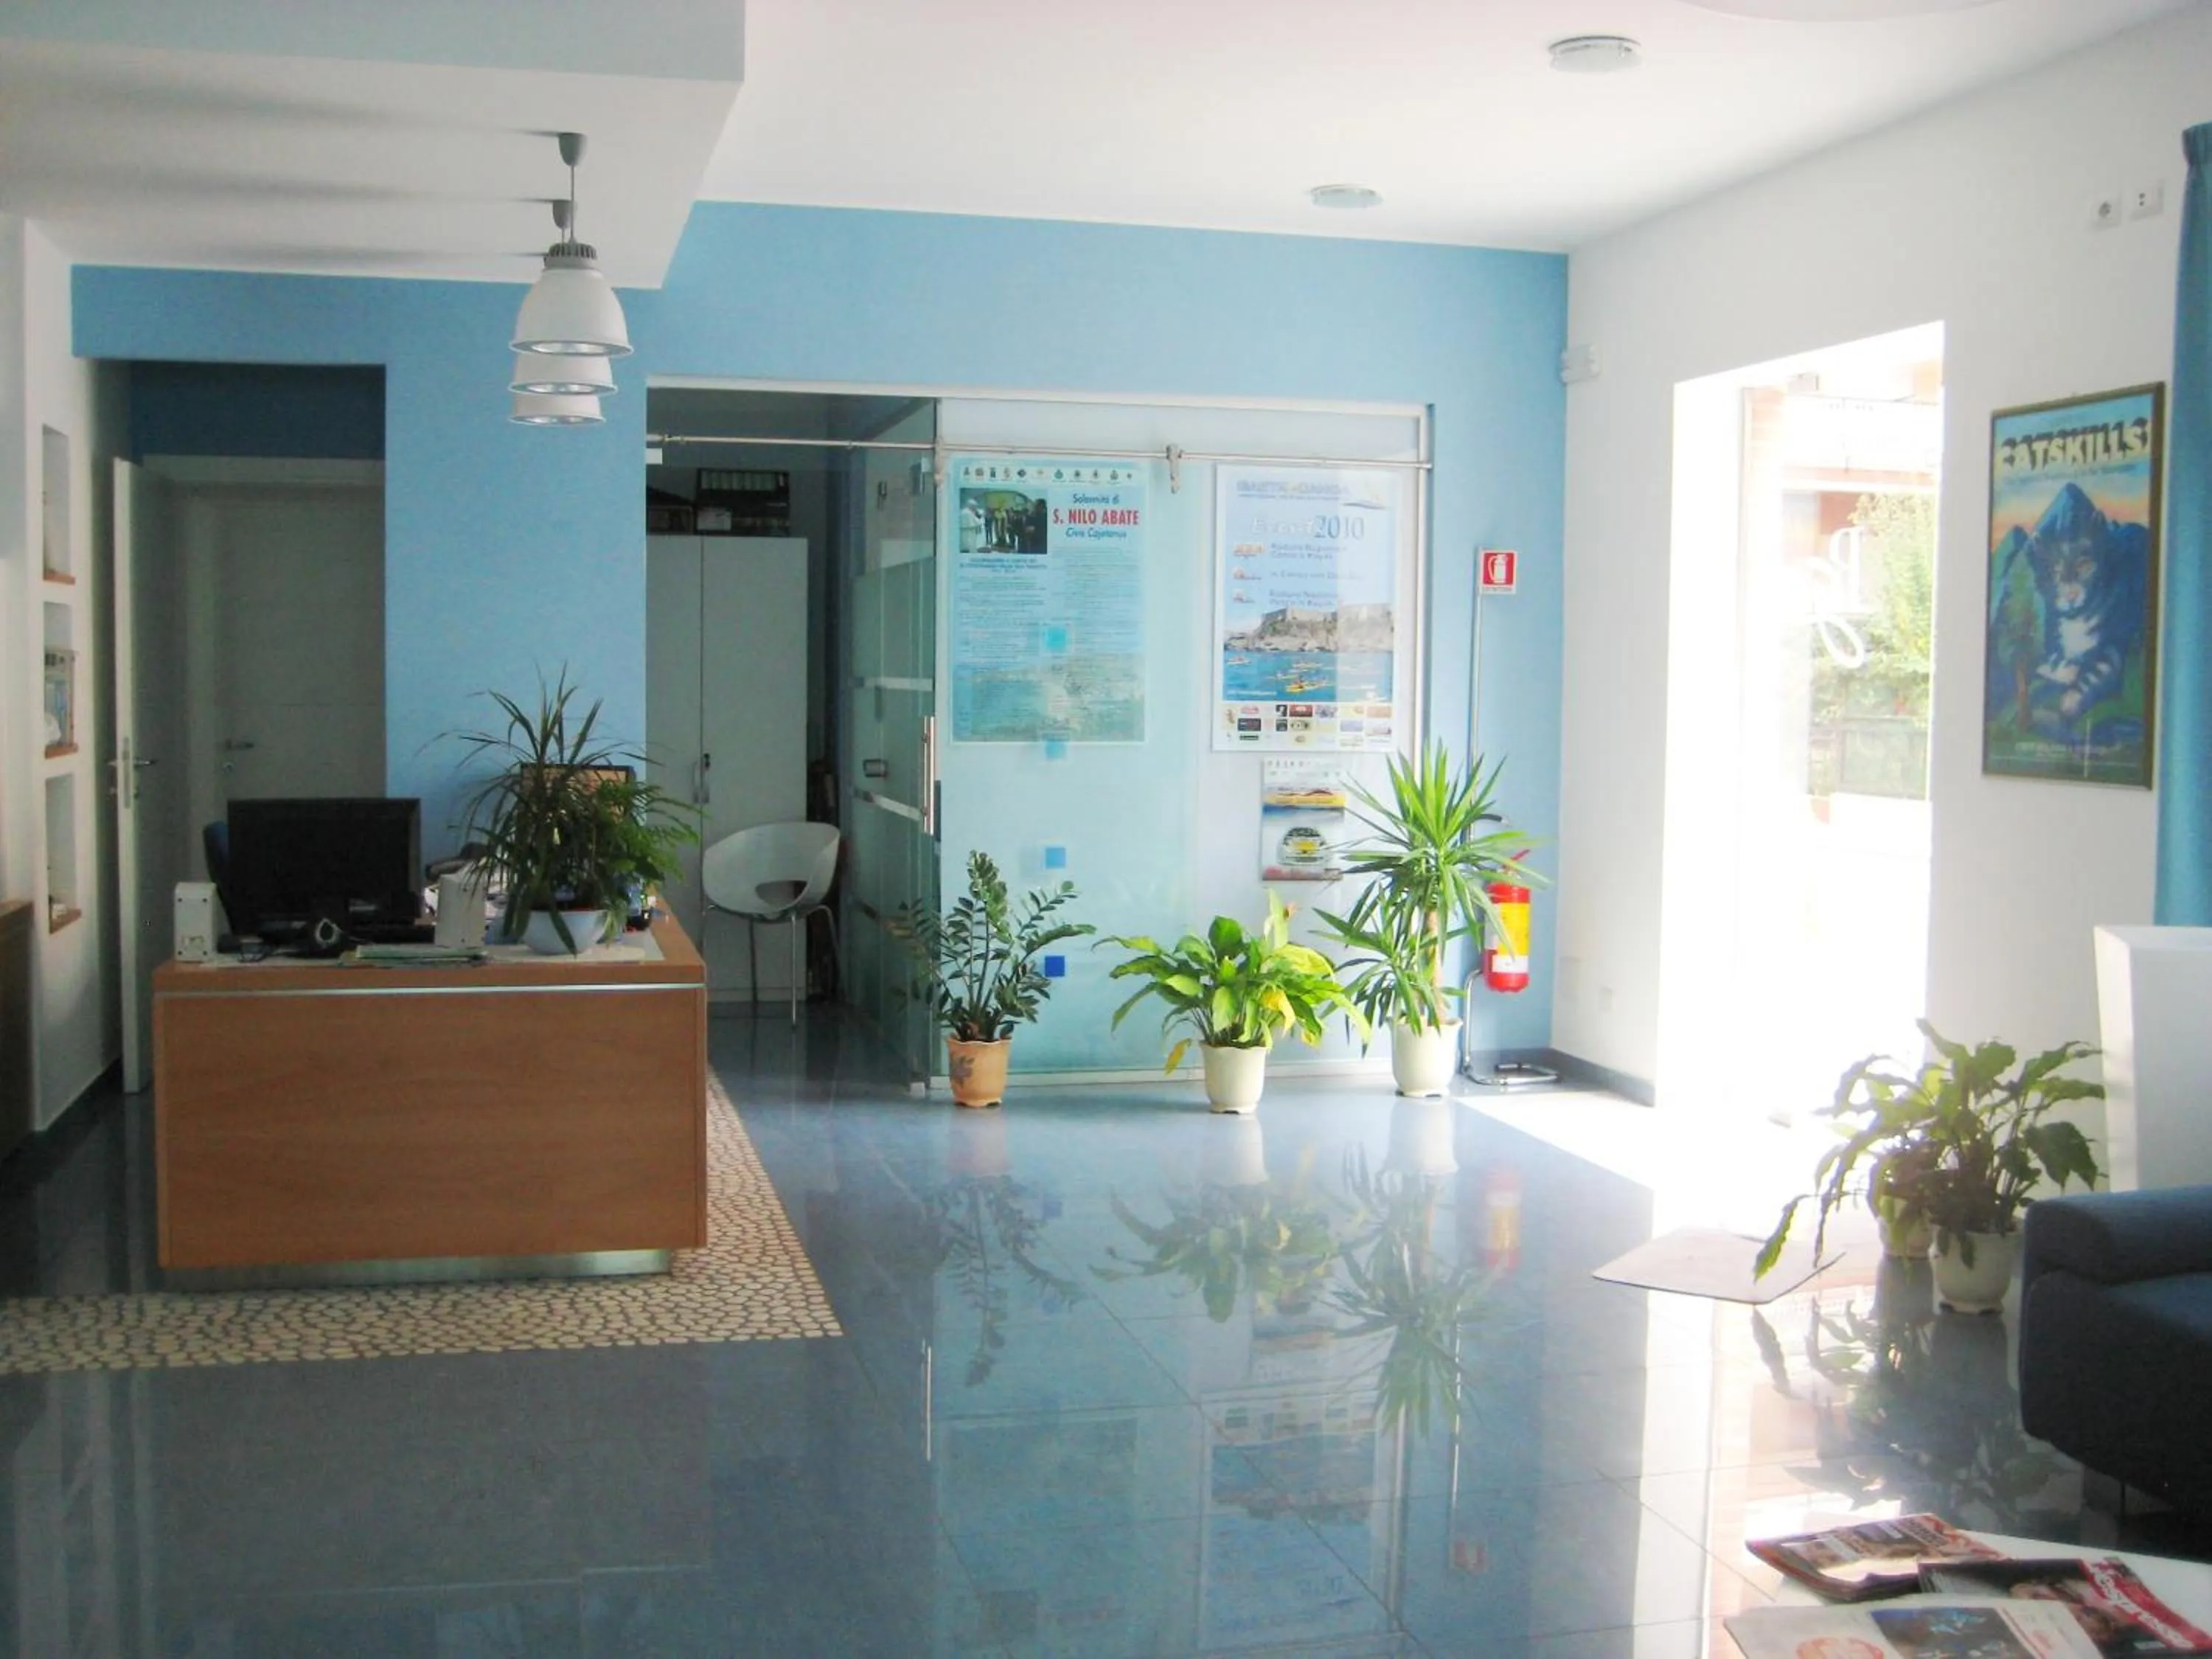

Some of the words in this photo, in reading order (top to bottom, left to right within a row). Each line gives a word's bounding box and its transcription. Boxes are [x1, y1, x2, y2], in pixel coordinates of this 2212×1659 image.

[1052, 508, 1064, 524] S.
[1068, 508, 1096, 524] NILO
[1102, 509, 1139, 525] ABATE
[1314, 515, 1365, 540] 2010
